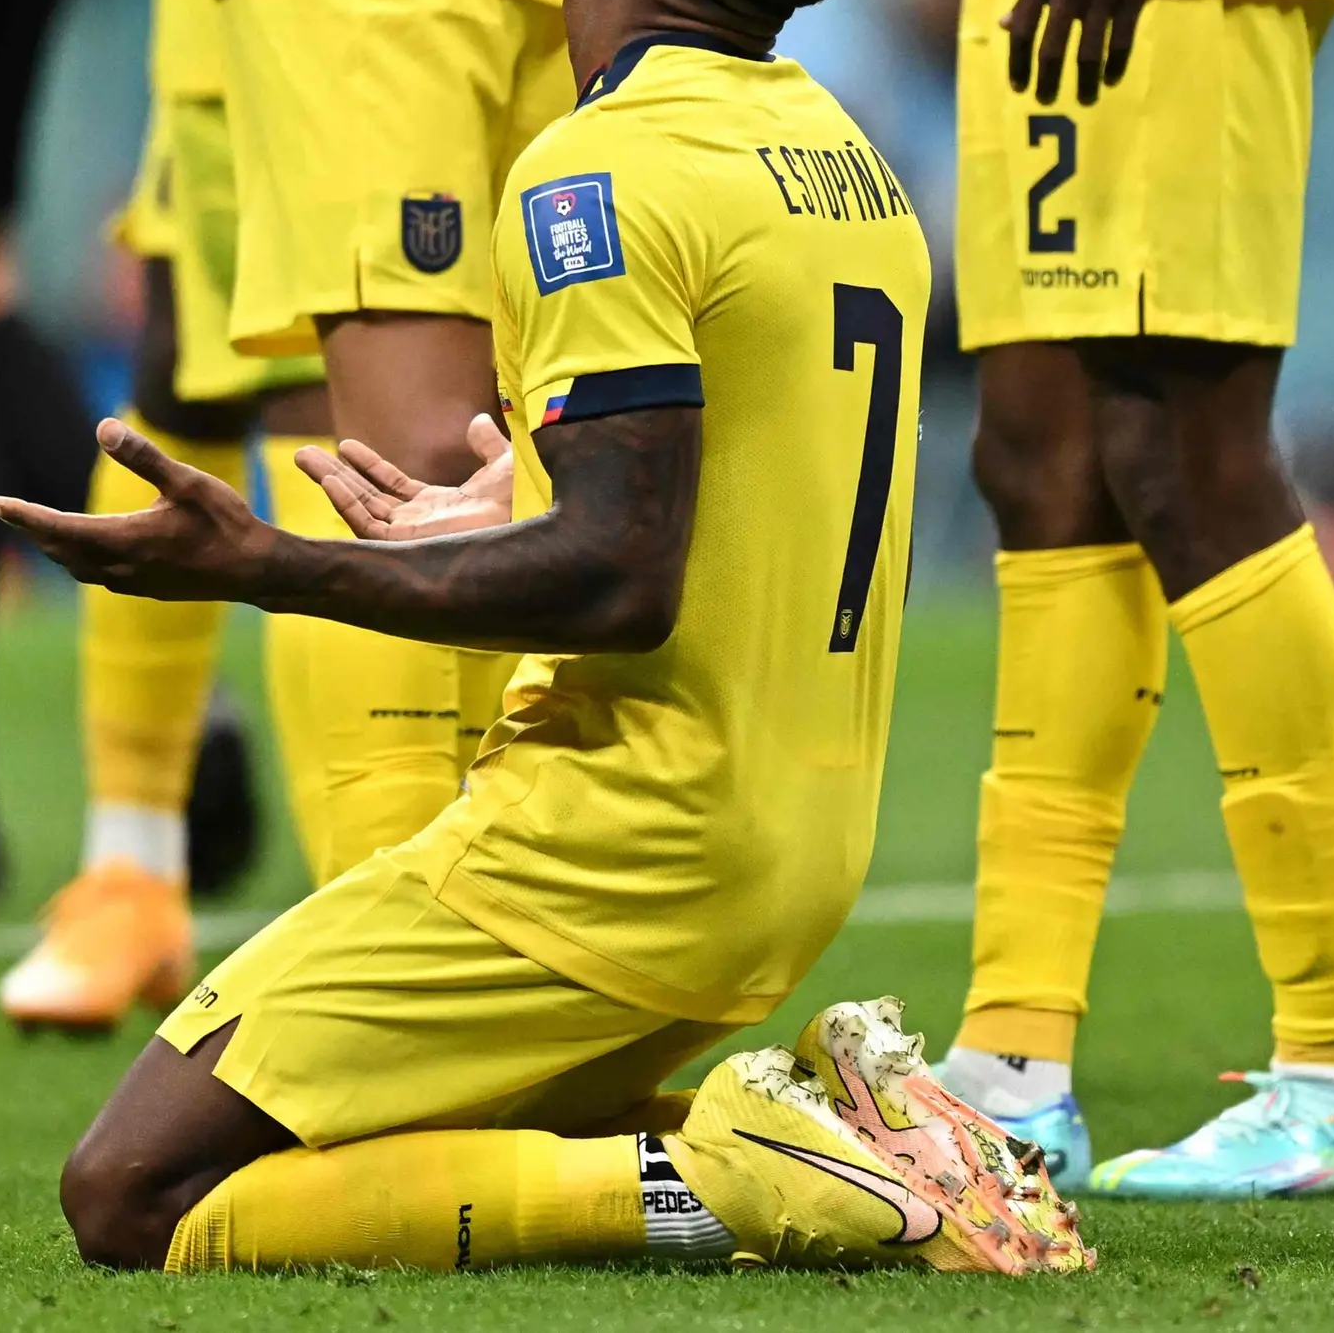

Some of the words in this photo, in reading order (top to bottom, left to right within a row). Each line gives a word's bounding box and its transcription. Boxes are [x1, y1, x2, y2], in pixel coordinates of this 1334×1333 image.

[756, 141, 915, 222] ESTUPIÑA
[1028, 114, 1077, 253] 2
[550, 218, 586, 235] FOOTBALL
[552, 228, 589, 248] UNITES
[553, 247, 566, 261] the
[566, 240, 592, 257] World
[829, 282, 904, 653] 7
